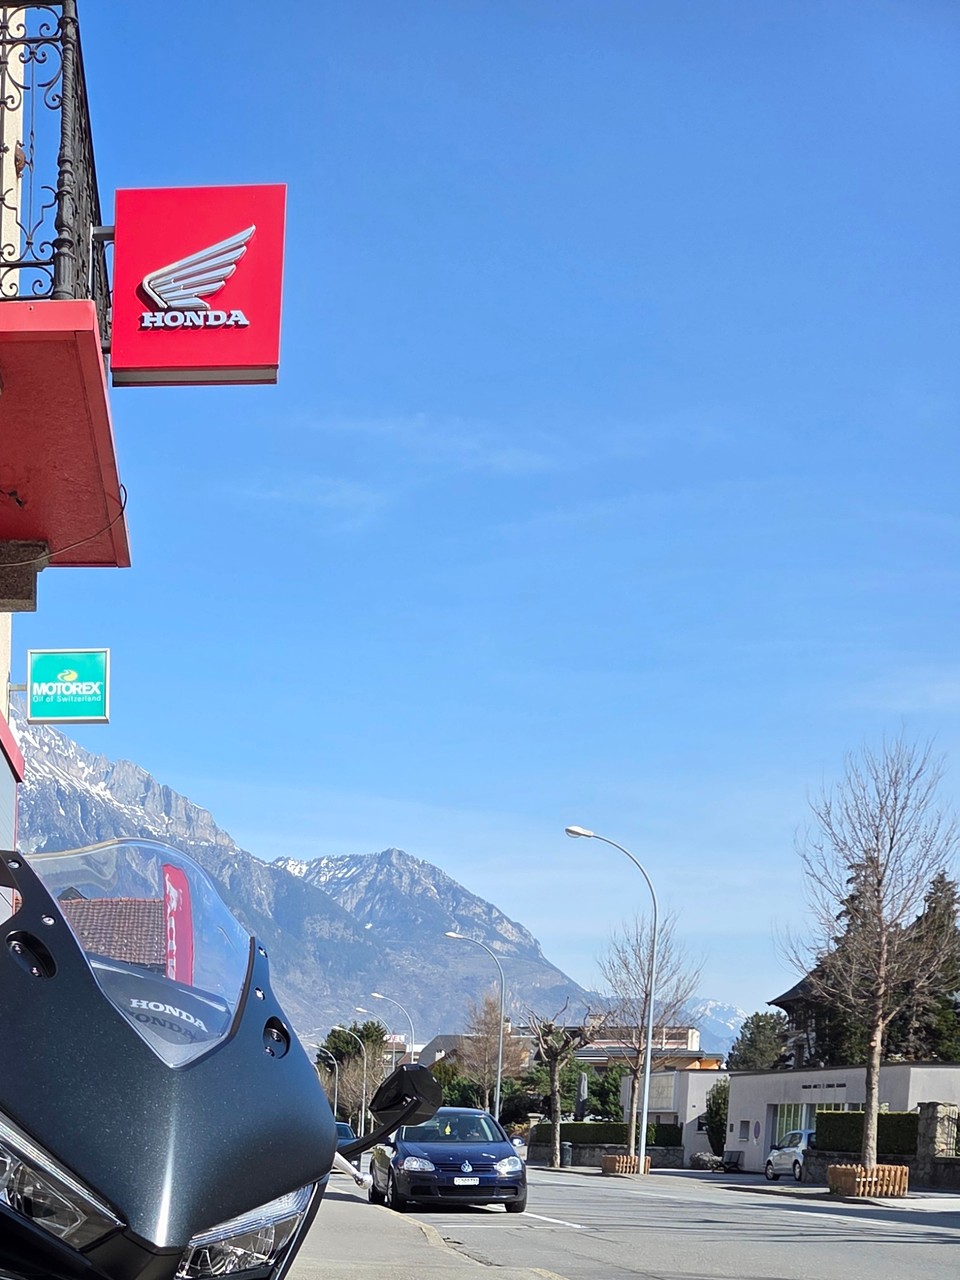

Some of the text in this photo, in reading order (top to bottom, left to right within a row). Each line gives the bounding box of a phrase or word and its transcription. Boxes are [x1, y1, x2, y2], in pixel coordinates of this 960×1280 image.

[141, 310, 250, 328] HONDA
[32, 682, 102, 695] MOTOREX
[45, 695, 54, 703] of
[56, 694, 102, 703] Switzerland
[130, 998, 208, 1033] HONDA
